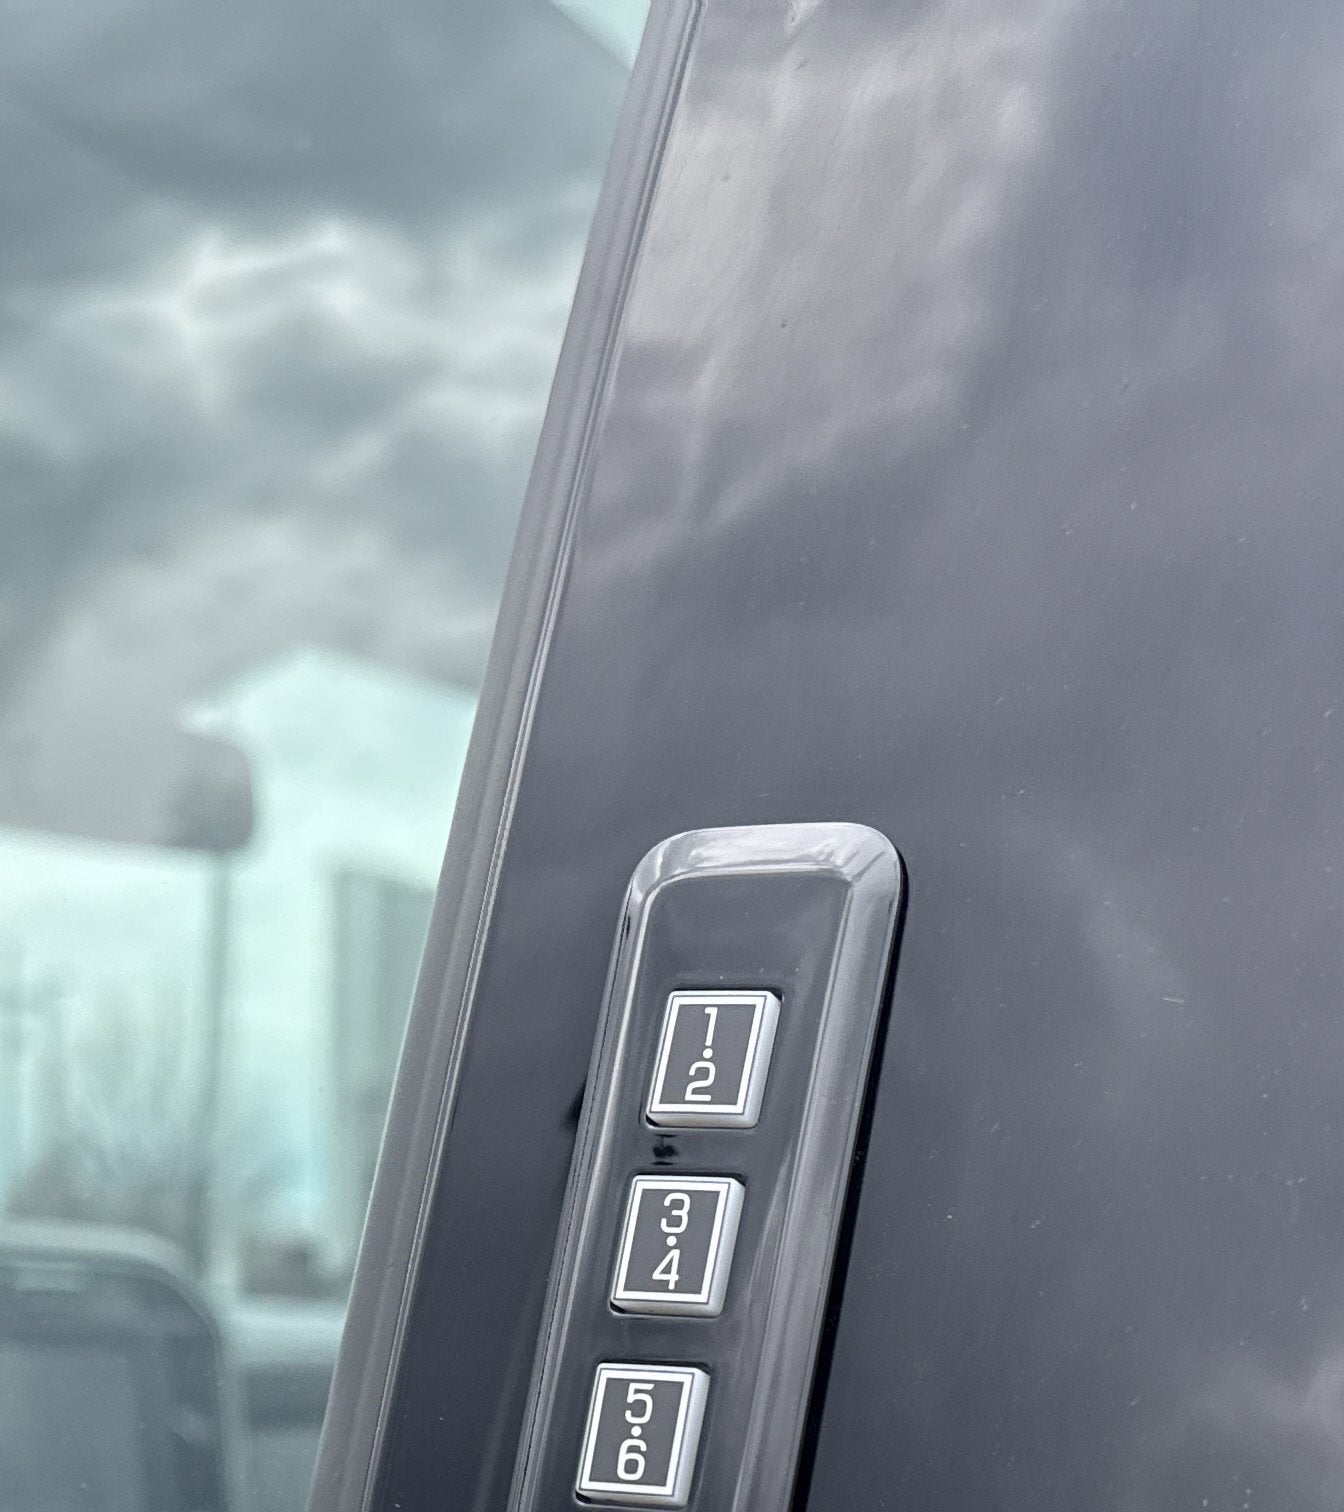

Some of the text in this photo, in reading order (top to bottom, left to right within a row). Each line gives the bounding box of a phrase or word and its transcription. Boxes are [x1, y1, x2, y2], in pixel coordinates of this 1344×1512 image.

[703, 1006, 718, 1047] 1
[684, 1060, 716, 1102] 2
[660, 1192, 691, 1234] 3
[651, 1248, 681, 1291] 4
[624, 1382, 655, 1424] 5
[616, 1438, 647, 1481] 6
